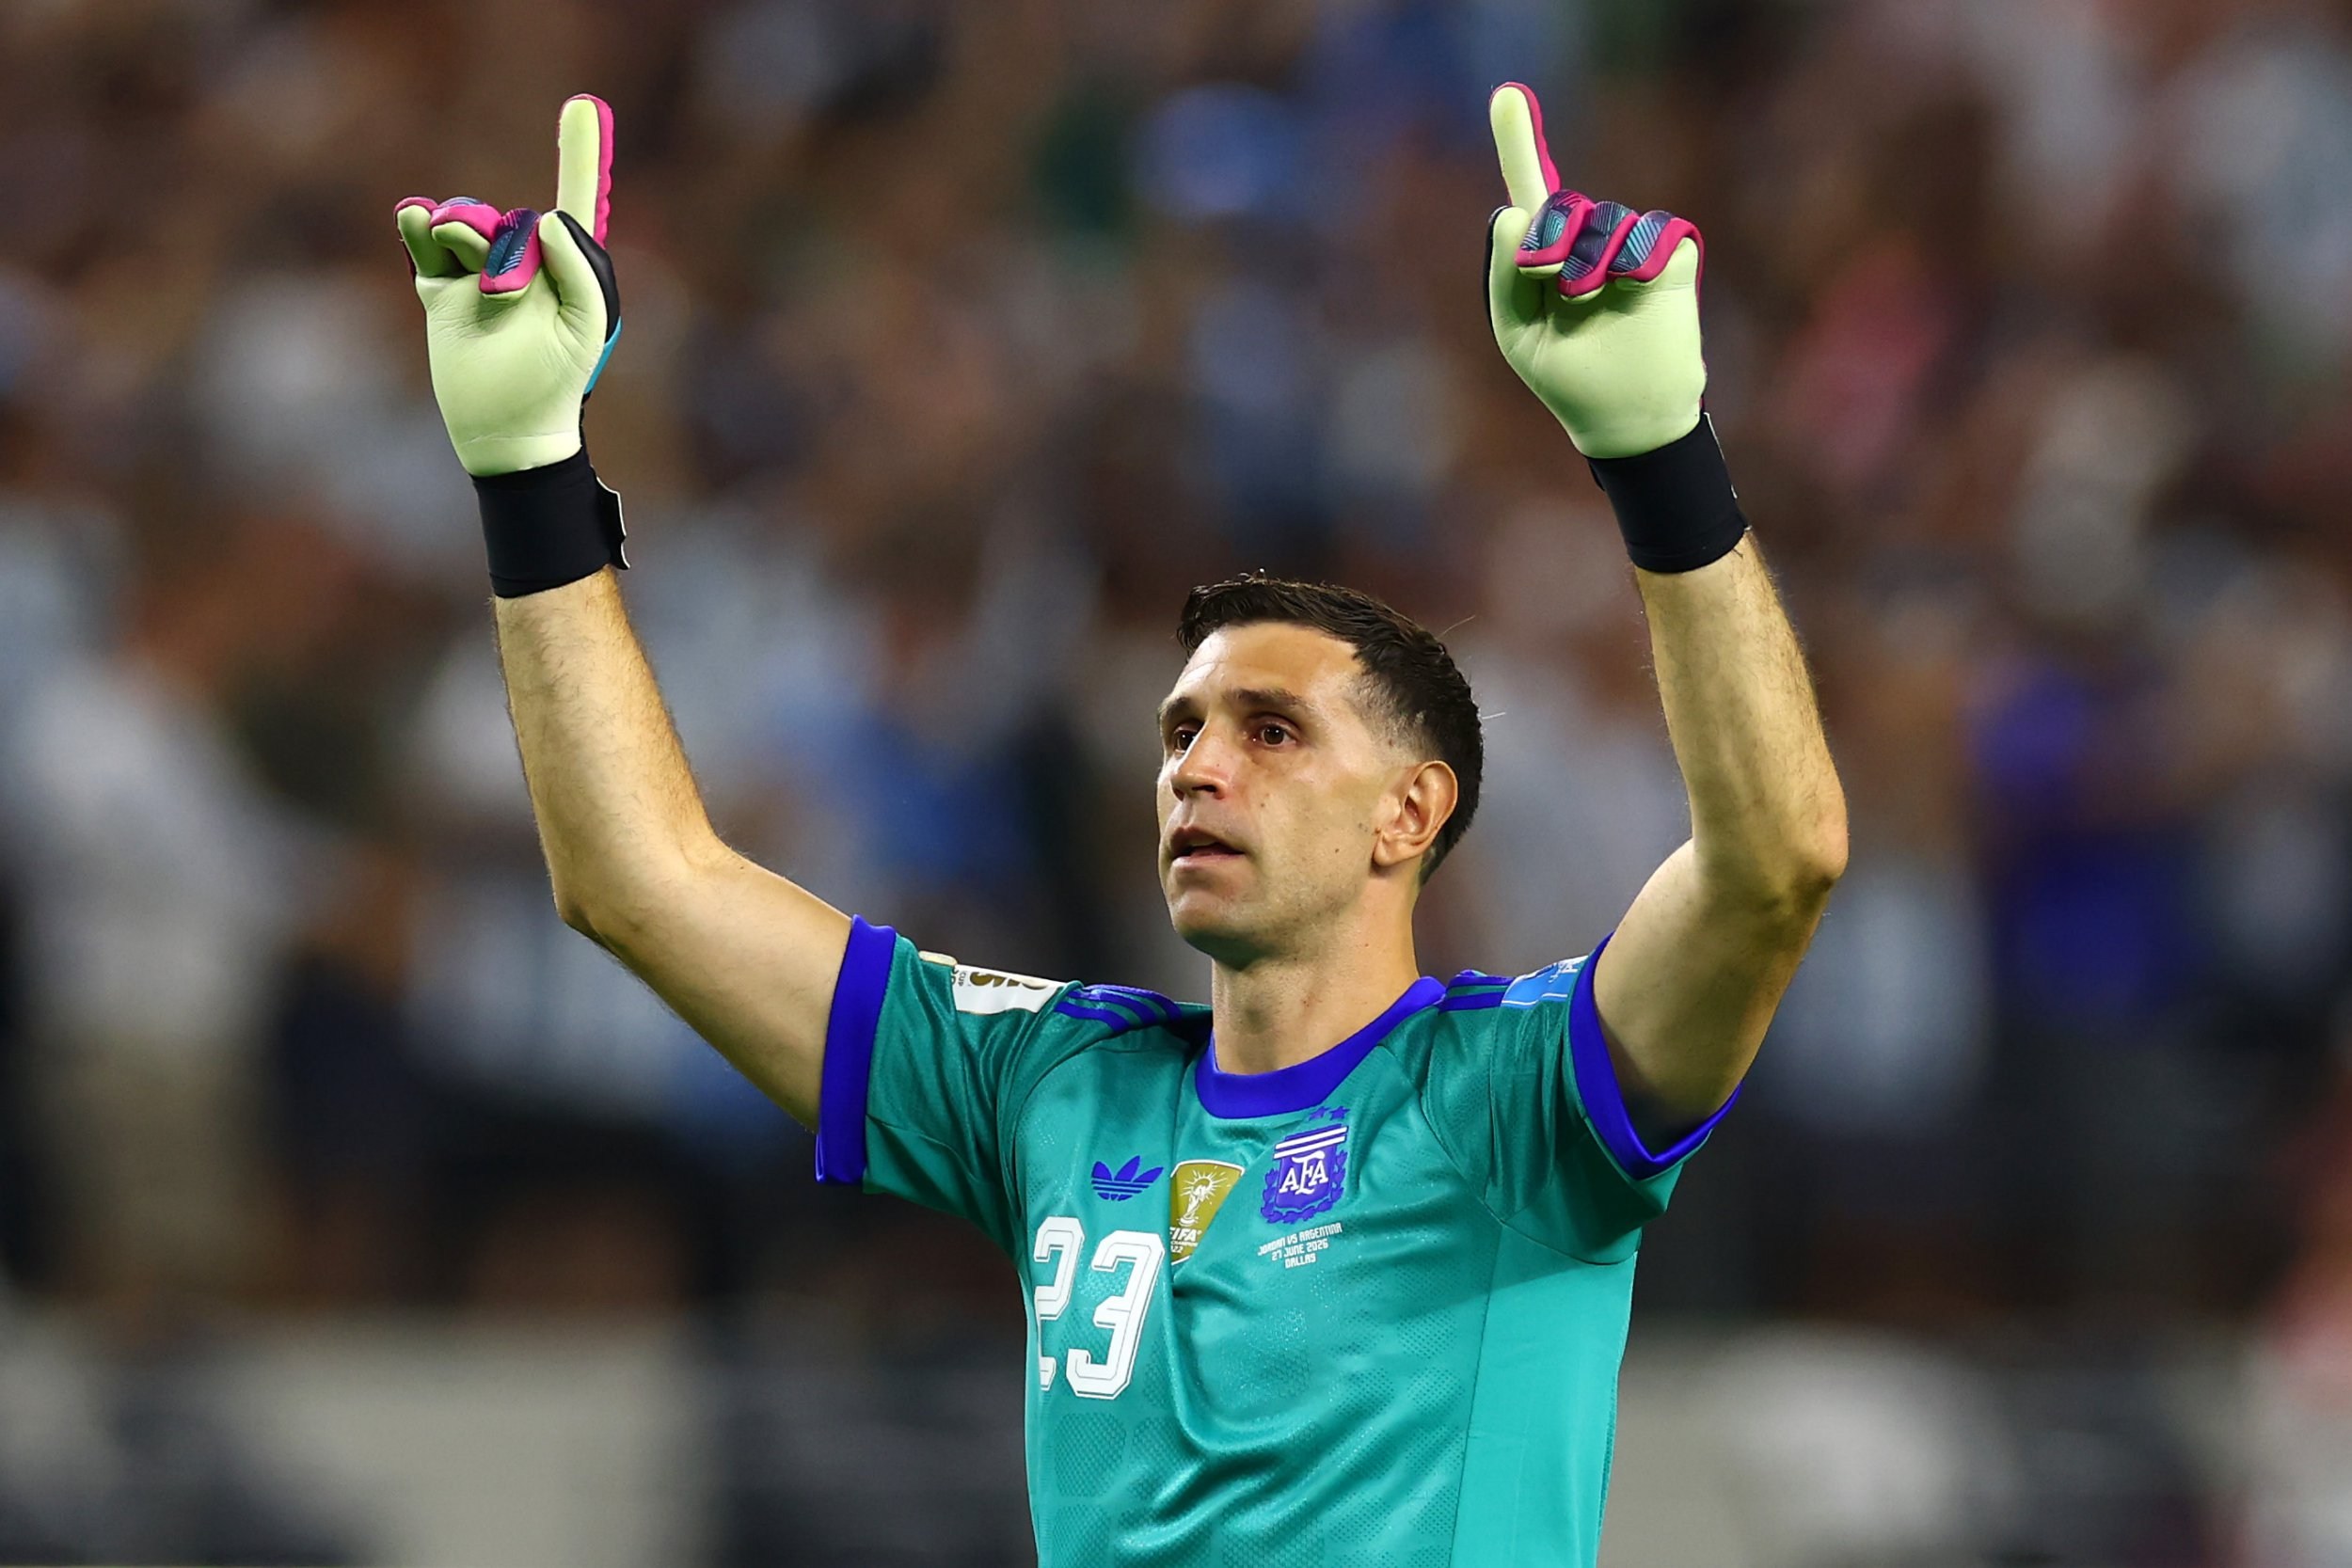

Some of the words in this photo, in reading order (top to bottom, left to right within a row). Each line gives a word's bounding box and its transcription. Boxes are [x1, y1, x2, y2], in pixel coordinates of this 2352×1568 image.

[1279, 1150, 1328, 1196] AFA
[1257, 1237, 1286, 1256] JORDAN
[1287, 1233, 1298, 1245] VS
[1299, 1222, 1343, 1243] ARGENTINA
[1271, 1249, 1282, 1261] 27
[1283, 1243, 1305, 1258] JUNE
[1306, 1238, 1329, 1252] 2026
[1284, 1253, 1316, 1269] DALLAS
[1033, 1216, 1166, 1400] 23
